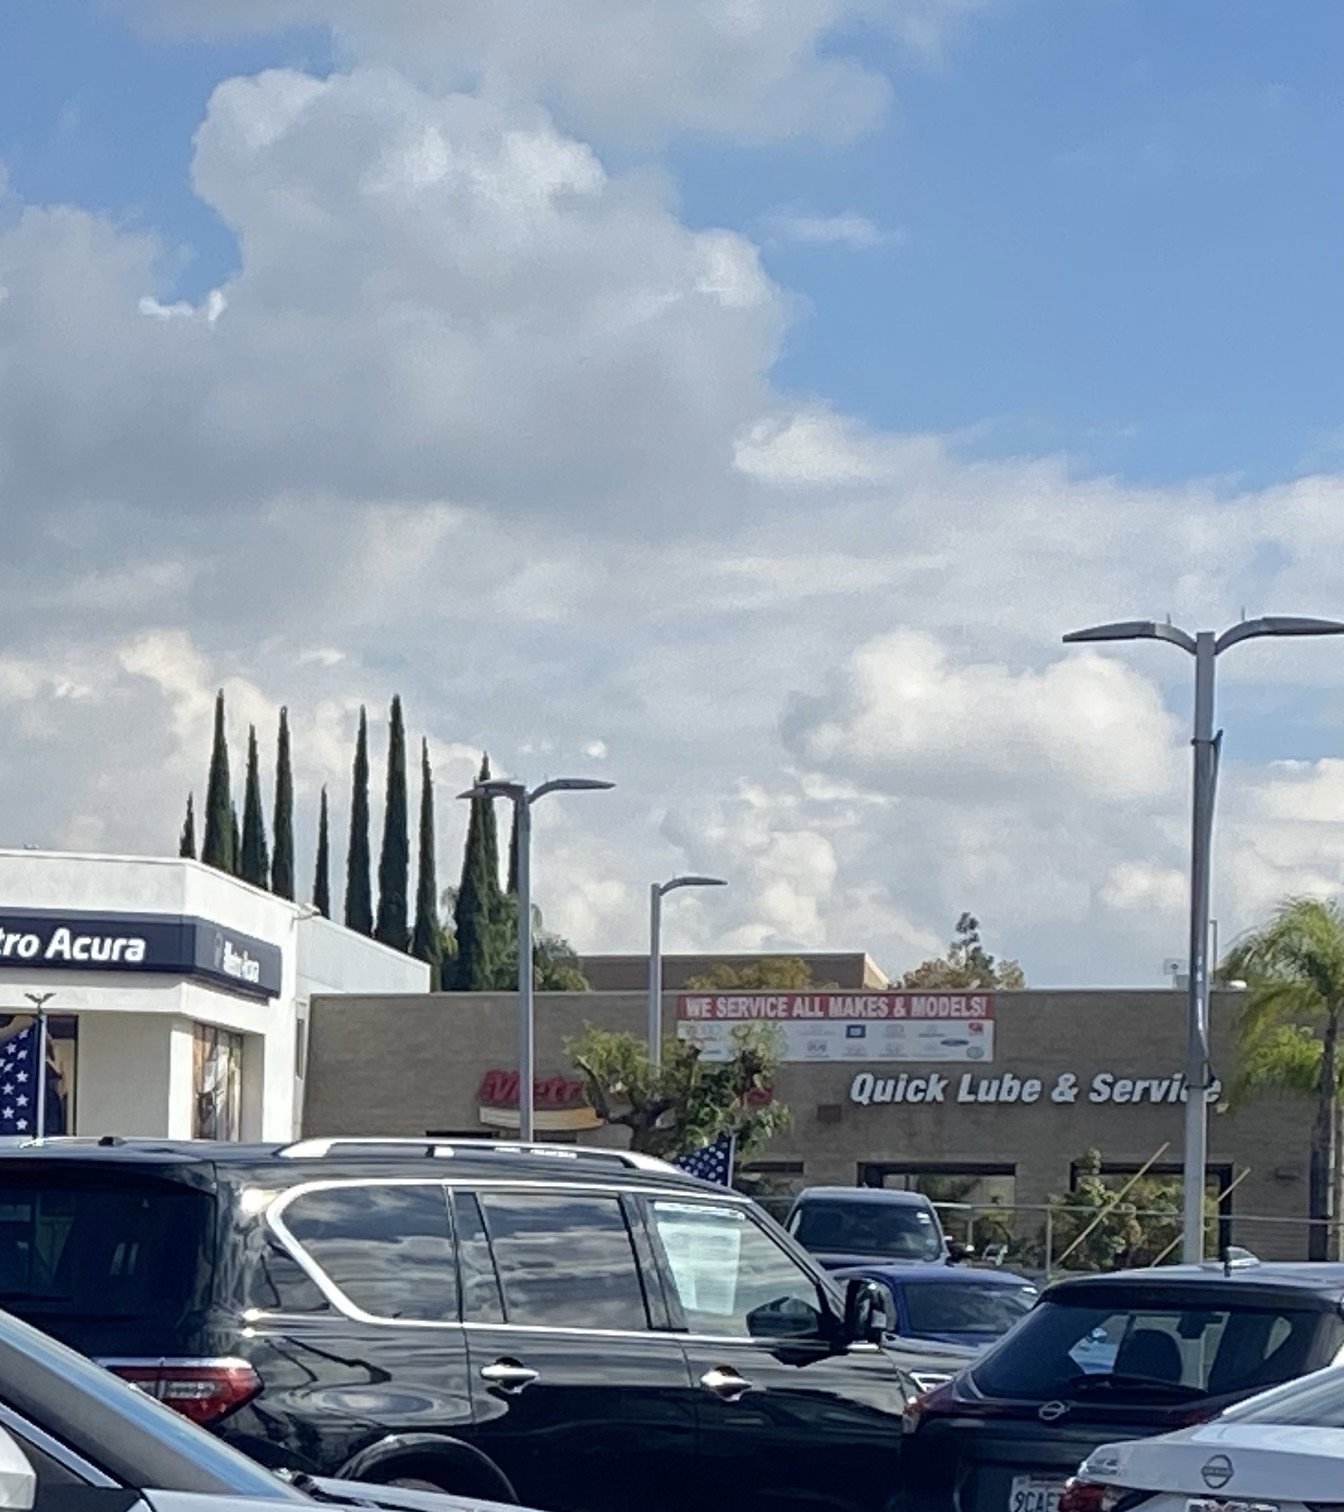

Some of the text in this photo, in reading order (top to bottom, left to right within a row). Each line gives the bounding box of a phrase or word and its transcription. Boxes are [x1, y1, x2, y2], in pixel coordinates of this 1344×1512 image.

[44, 927, 147, 963] Acura
[686, 995, 988, 1019] WE SERVICE ALL MAKES & MODELS!
[850, 1073, 948, 1105] Quick
[956, 1073, 1043, 1103] Lube
[1051, 1073, 1080, 1103] &
